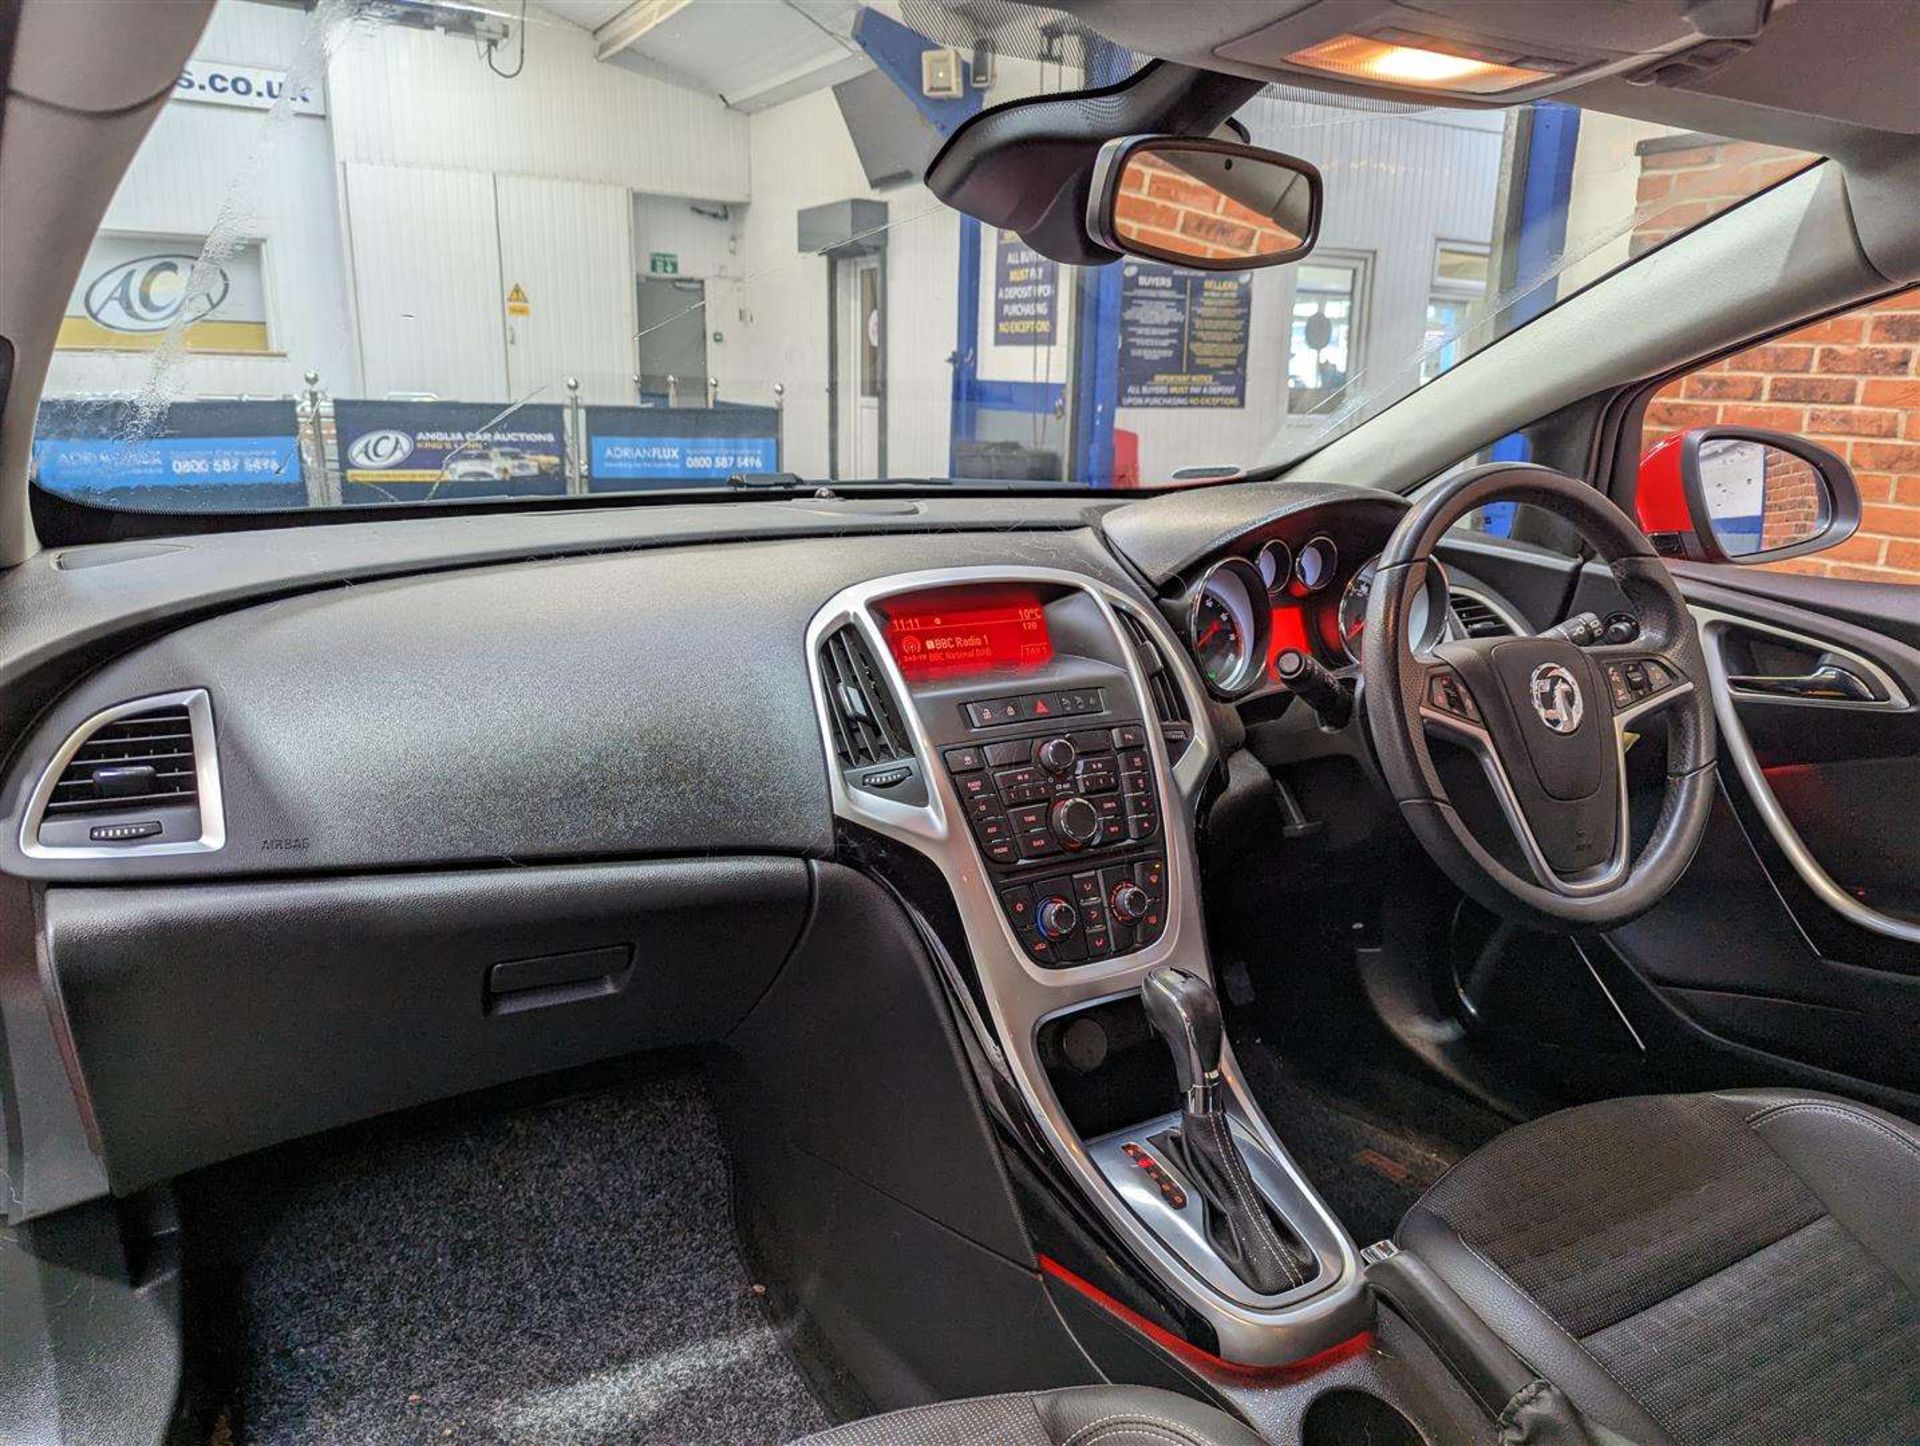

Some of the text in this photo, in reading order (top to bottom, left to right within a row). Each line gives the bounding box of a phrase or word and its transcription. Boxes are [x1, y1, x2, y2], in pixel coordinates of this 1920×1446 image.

[1138, 276, 1173, 288] BUYERS
[1003, 302, 1048, 316] PURCHASNG
[1127, 386, 1140, 394] ALL
[416, 432, 556, 443] ANGLIA CAR AUCTIONS
[355, 435, 409, 463] ACA
[685, 455, 712, 469] 0800
[714, 455, 734, 469] 587
[736, 455, 763, 469] 5496
[893, 618, 920, 631] 11:11
[935, 634, 989, 650] BBC Radio 1
[260, 837, 310, 851] AIRBAG
